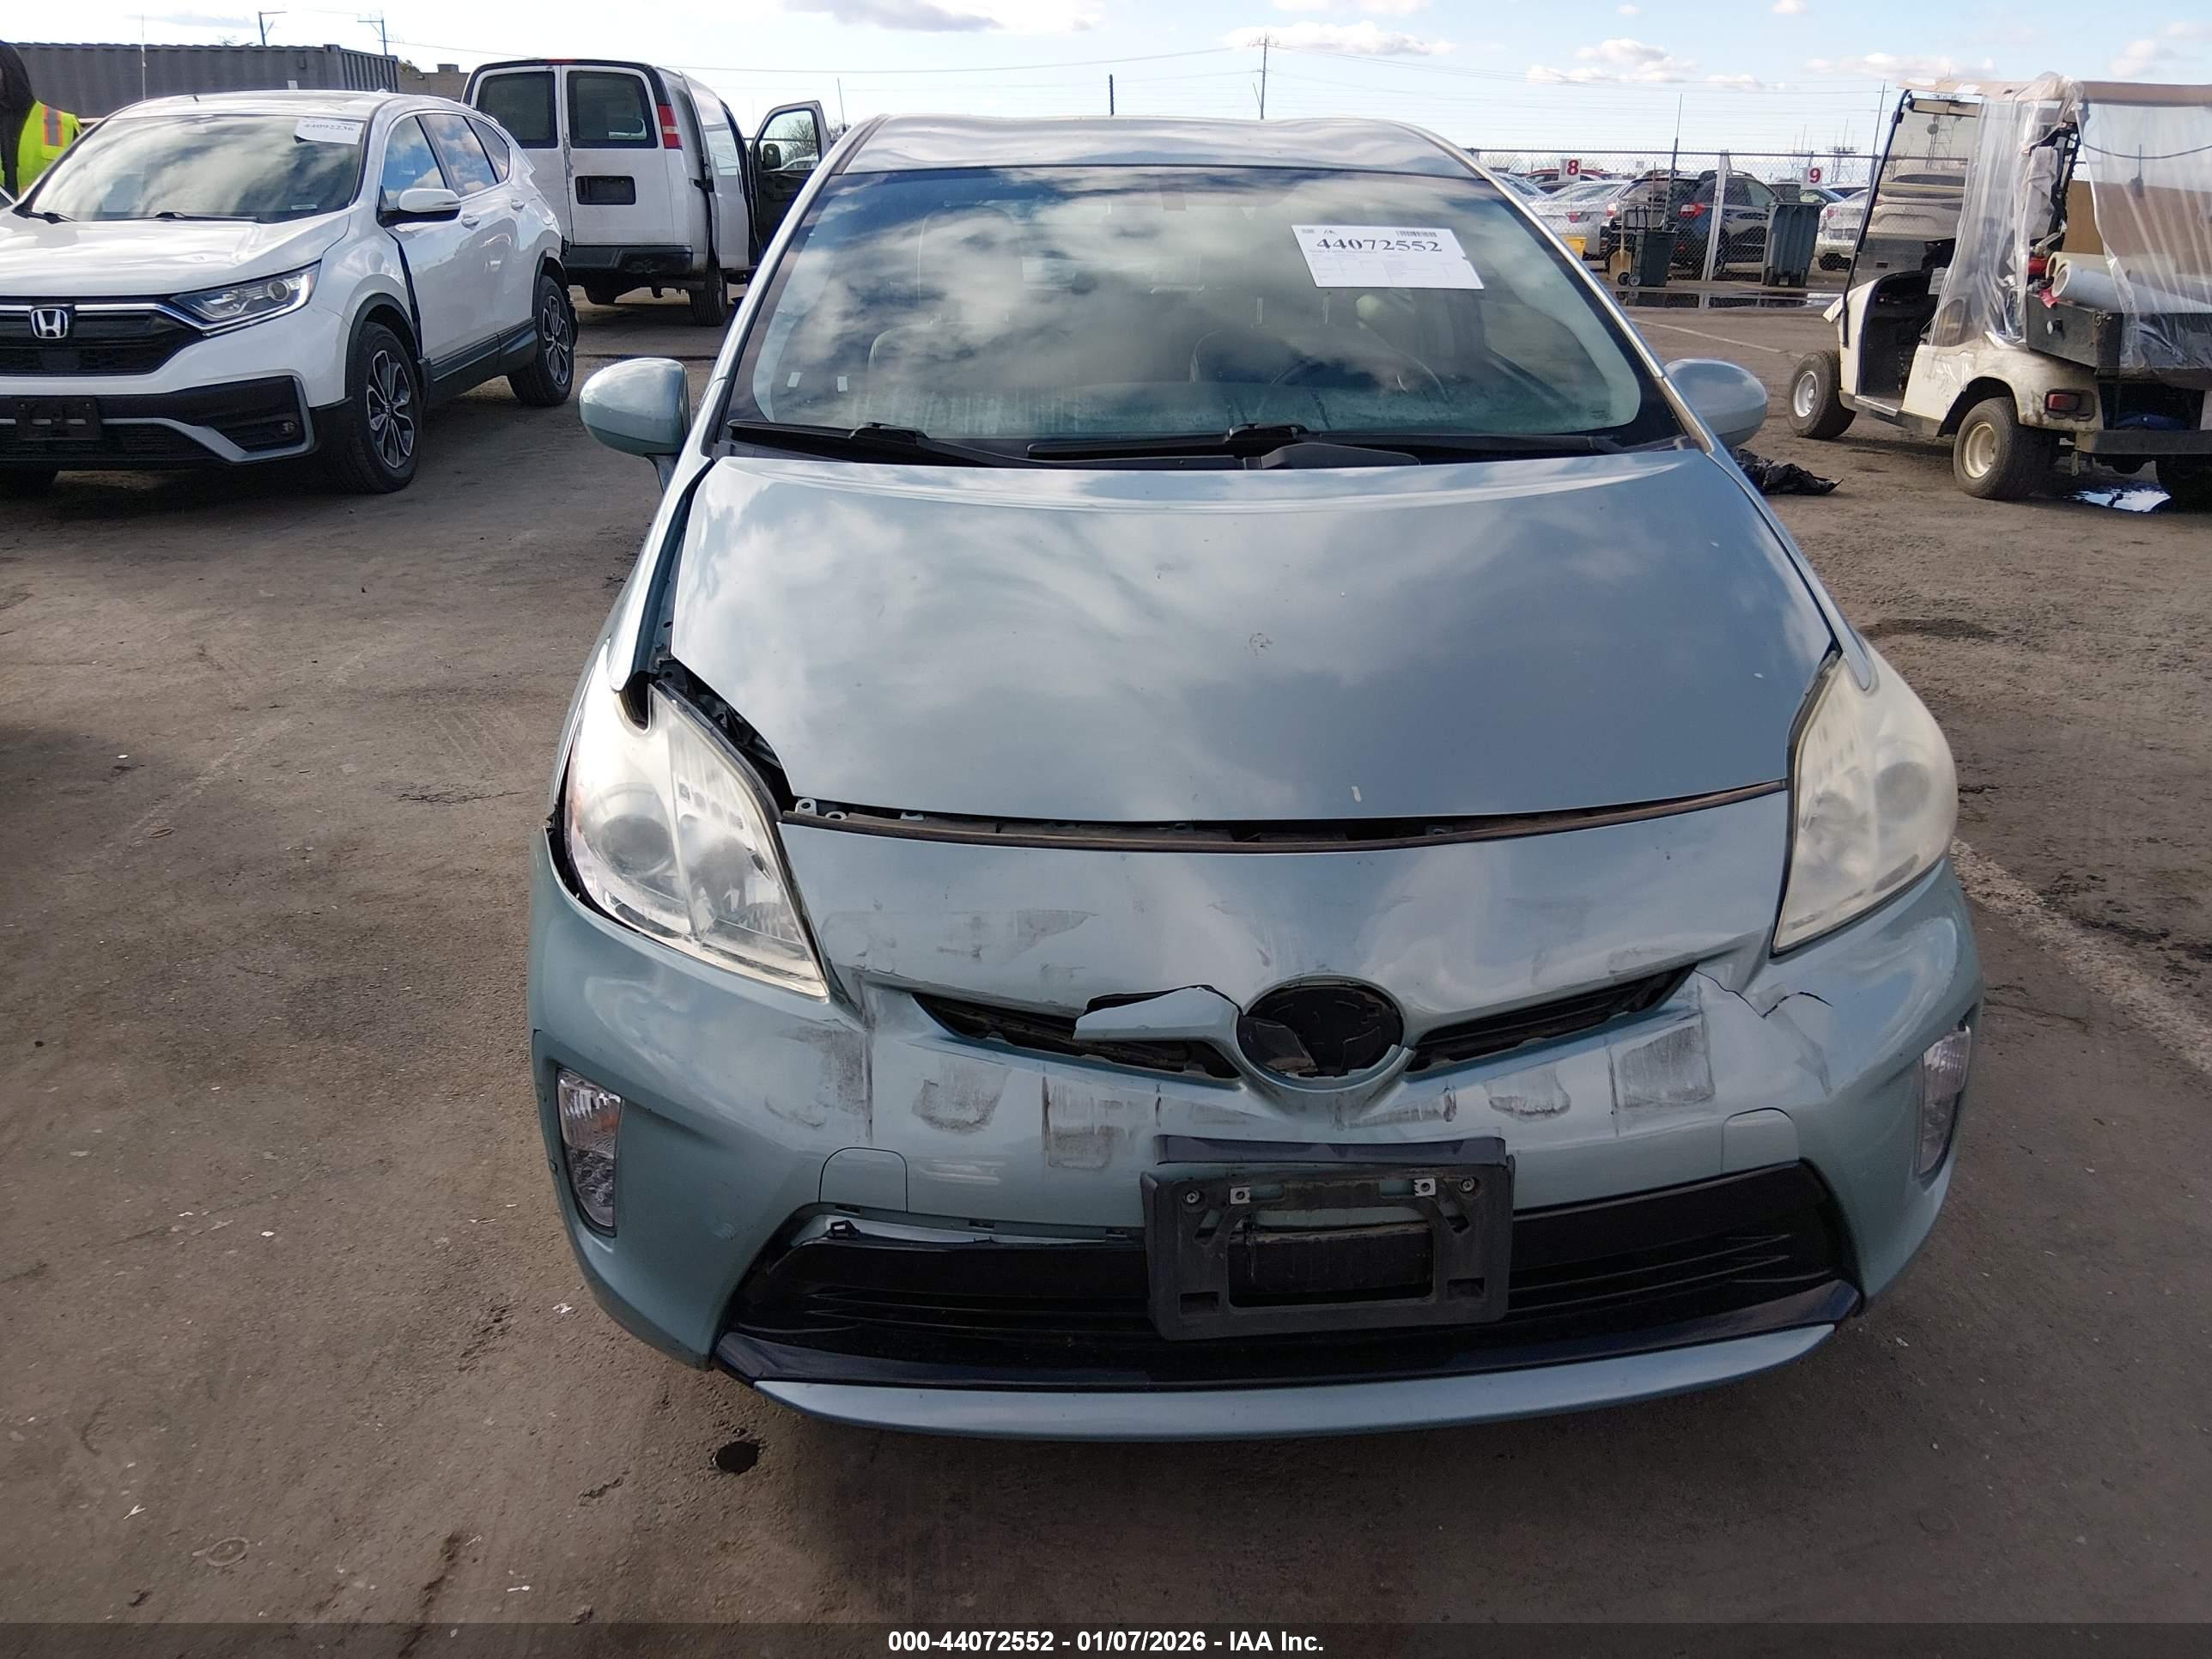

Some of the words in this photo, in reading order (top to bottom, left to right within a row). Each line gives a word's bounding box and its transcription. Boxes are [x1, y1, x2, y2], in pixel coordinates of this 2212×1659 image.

[1567, 160, 1579, 175] 8
[1808, 168, 1821, 183] 9
[1316, 238, 1443, 252] 44072552
